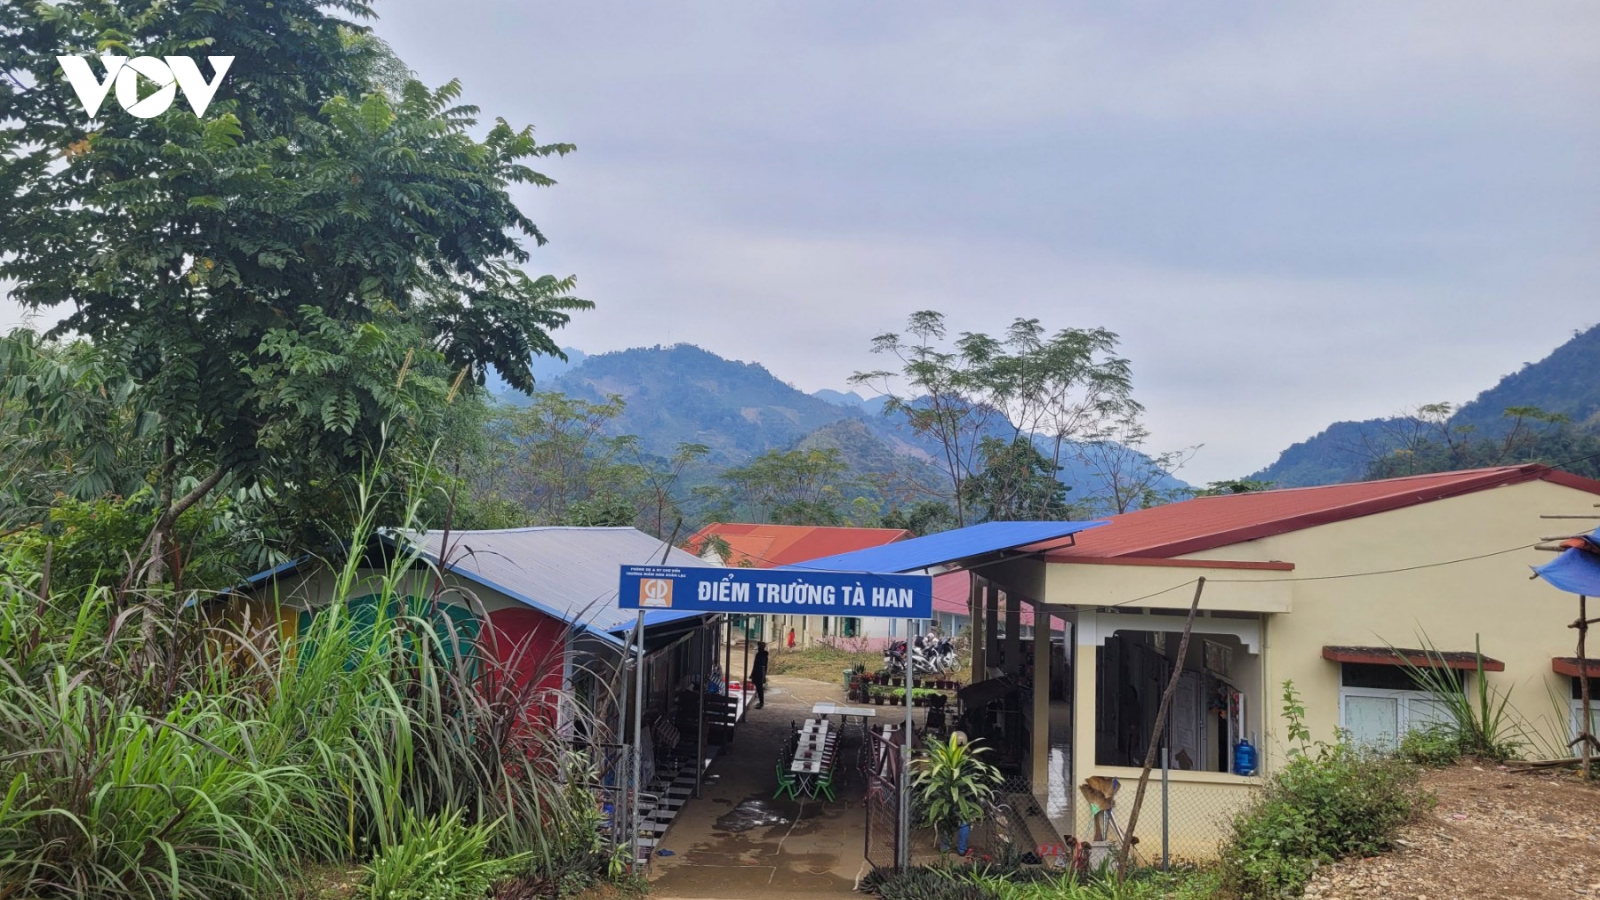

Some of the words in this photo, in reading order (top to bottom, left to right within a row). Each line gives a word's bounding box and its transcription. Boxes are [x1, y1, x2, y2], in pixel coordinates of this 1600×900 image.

[698, 574, 750, 602] ĐIỂM
[756, 578, 836, 606] TRƯỜNG
[841, 582, 866, 606] TÀ
[872, 587, 912, 608] HAN
